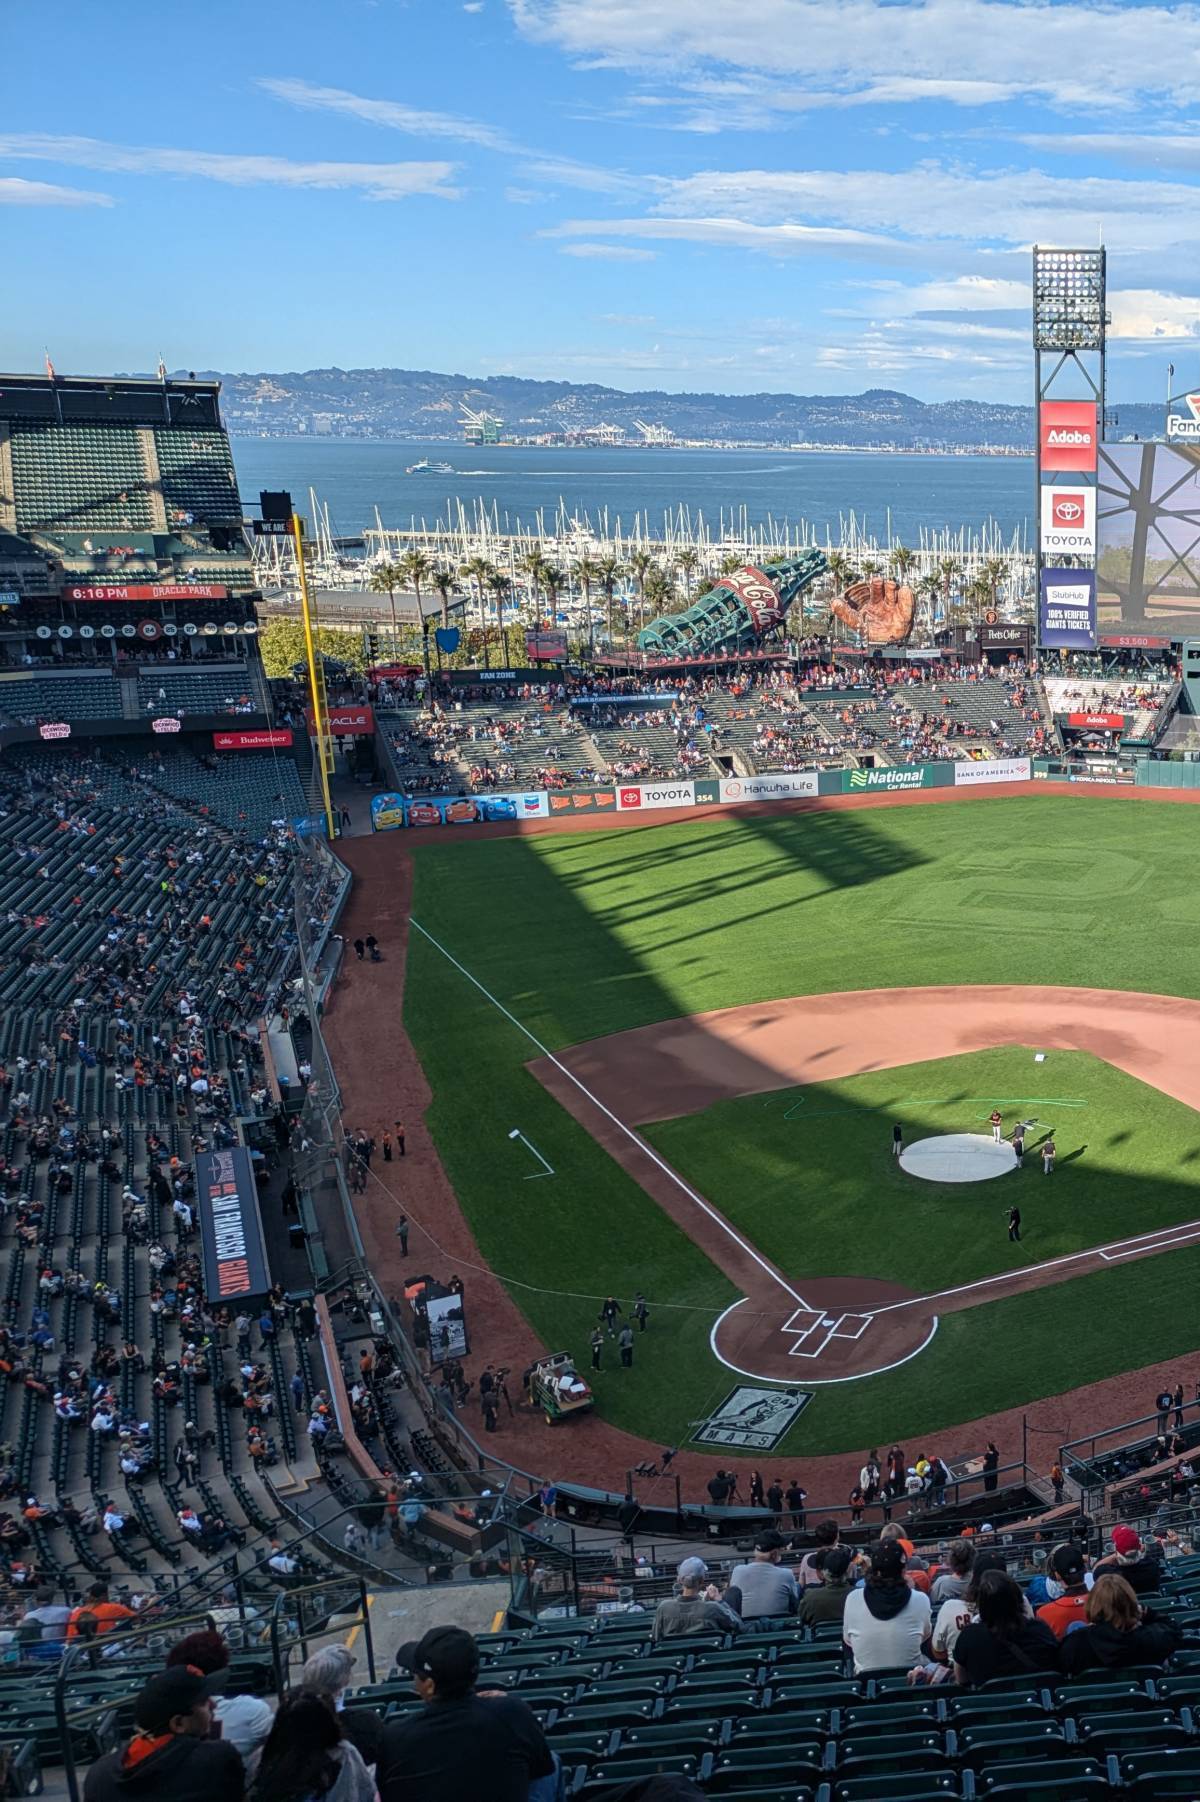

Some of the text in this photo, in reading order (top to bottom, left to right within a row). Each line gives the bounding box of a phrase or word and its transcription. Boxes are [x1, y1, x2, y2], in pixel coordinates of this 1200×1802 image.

[1047, 430, 1092, 444] Adobe
[261, 523, 285, 532] WE ARE
[1044, 535, 1092, 546] TOYOTA
[72, 587, 128, 599] 6:16 PM
[153, 585, 213, 598] ORACLE PARK
[1052, 590, 1084, 600] StubHub
[1047, 609, 1089, 620] 100% VERIFIED
[1046, 619, 1091, 630] GIANTS TICKETS
[1003, 629, 1021, 640] Coffee
[496, 671, 516, 679] ZONE
[1086, 716, 1108, 724] Adobe
[240, 735, 287, 744] Budweiser
[868, 768, 925, 785] National
[985, 768, 1014, 776] AMERICA
[744, 781, 813, 794] Hanwha Life
[645, 789, 691, 801] TOYOTA
[697, 794, 713, 802] 354
[211, 1194, 241, 1213] SAN
[213, 1211, 247, 1260] FRANCISCO
[217, 1259, 251, 1296] GIANTS
[706, 1430, 769, 1446] MAYS
